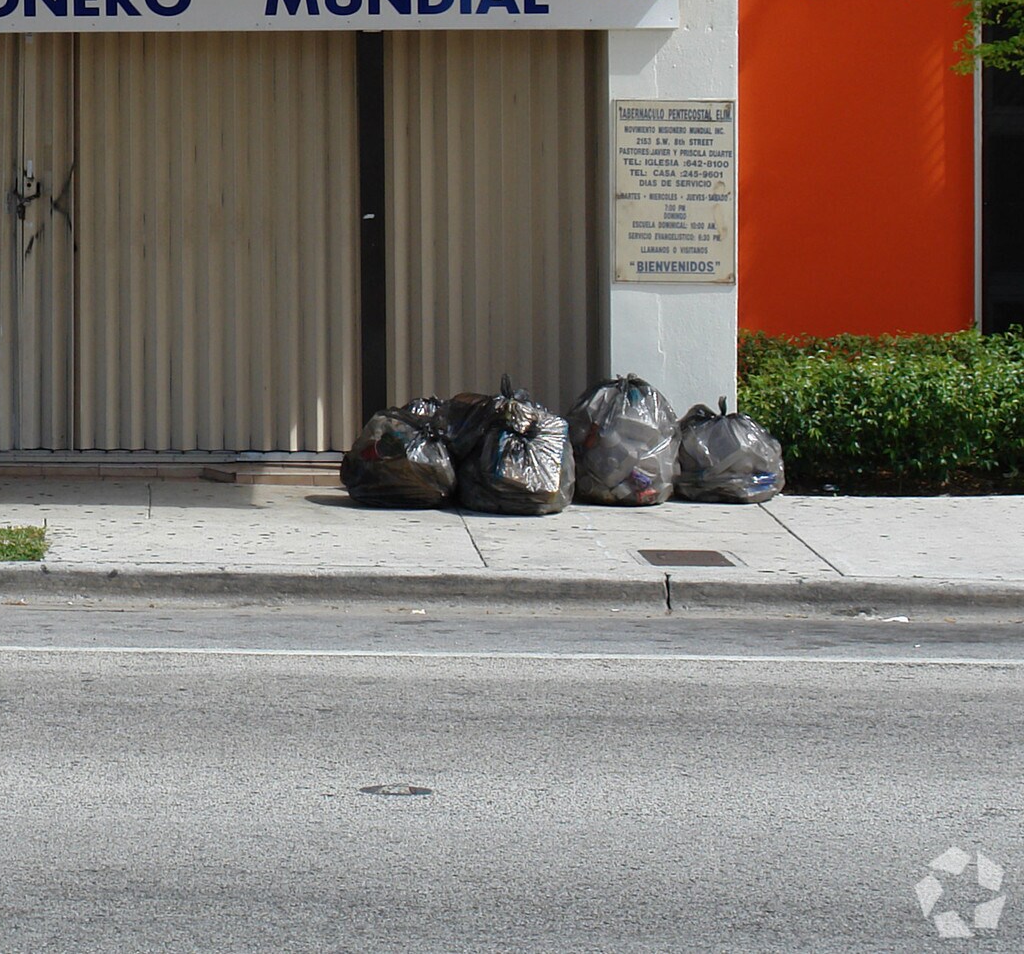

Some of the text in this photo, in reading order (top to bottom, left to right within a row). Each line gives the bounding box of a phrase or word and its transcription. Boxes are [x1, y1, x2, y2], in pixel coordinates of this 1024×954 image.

[619, 108, 664, 119] TABERNACULO
[669, 109, 712, 120] PENTECOSTAL
[658, 126, 686, 134] MISIONERO
[641, 246, 669, 254] LLAMANOS
[673, 246, 677, 254] O
